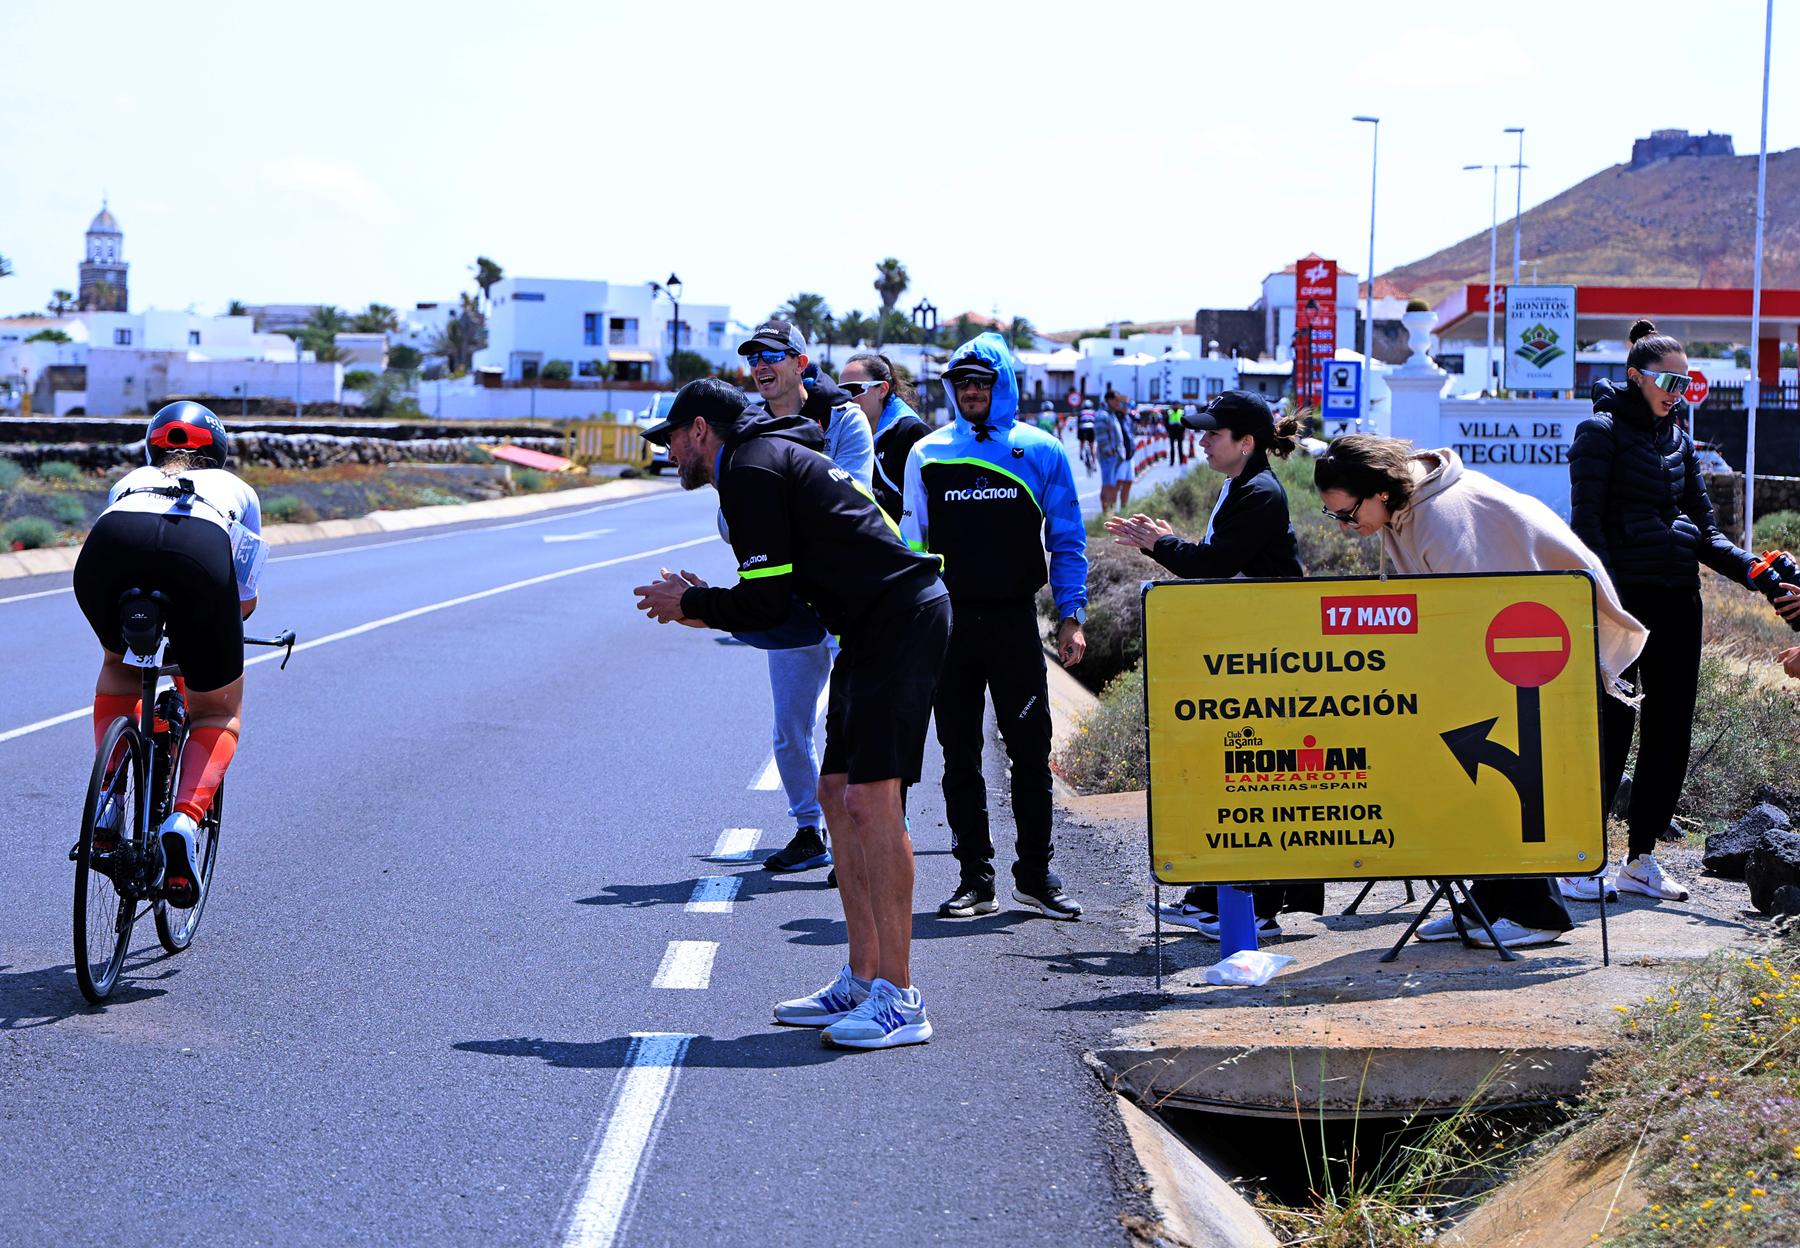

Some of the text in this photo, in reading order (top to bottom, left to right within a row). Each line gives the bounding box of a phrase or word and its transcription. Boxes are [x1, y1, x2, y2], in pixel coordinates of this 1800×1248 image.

[1515, 302, 1566, 310] BONITOS
[1530, 310, 1569, 319] ESPAÑA
[1459, 422, 1562, 438] VILLA DE
[1452, 443, 1570, 465] TEGUISE
[1326, 606, 1412, 626] 17 MAYO
[1203, 647, 1386, 676] VEHÍCULOS
[1174, 689, 1418, 721] ORGANIZACIÓN
[1225, 746, 1367, 774] IRONMAN
[1225, 771, 1368, 783] LANZAROTE
[1225, 781, 1368, 793] CANARIAS SPAIN
[1218, 804, 1383, 824] POR INTERIOR
[1206, 828, 1395, 851] VILLA (ARNILLA)
